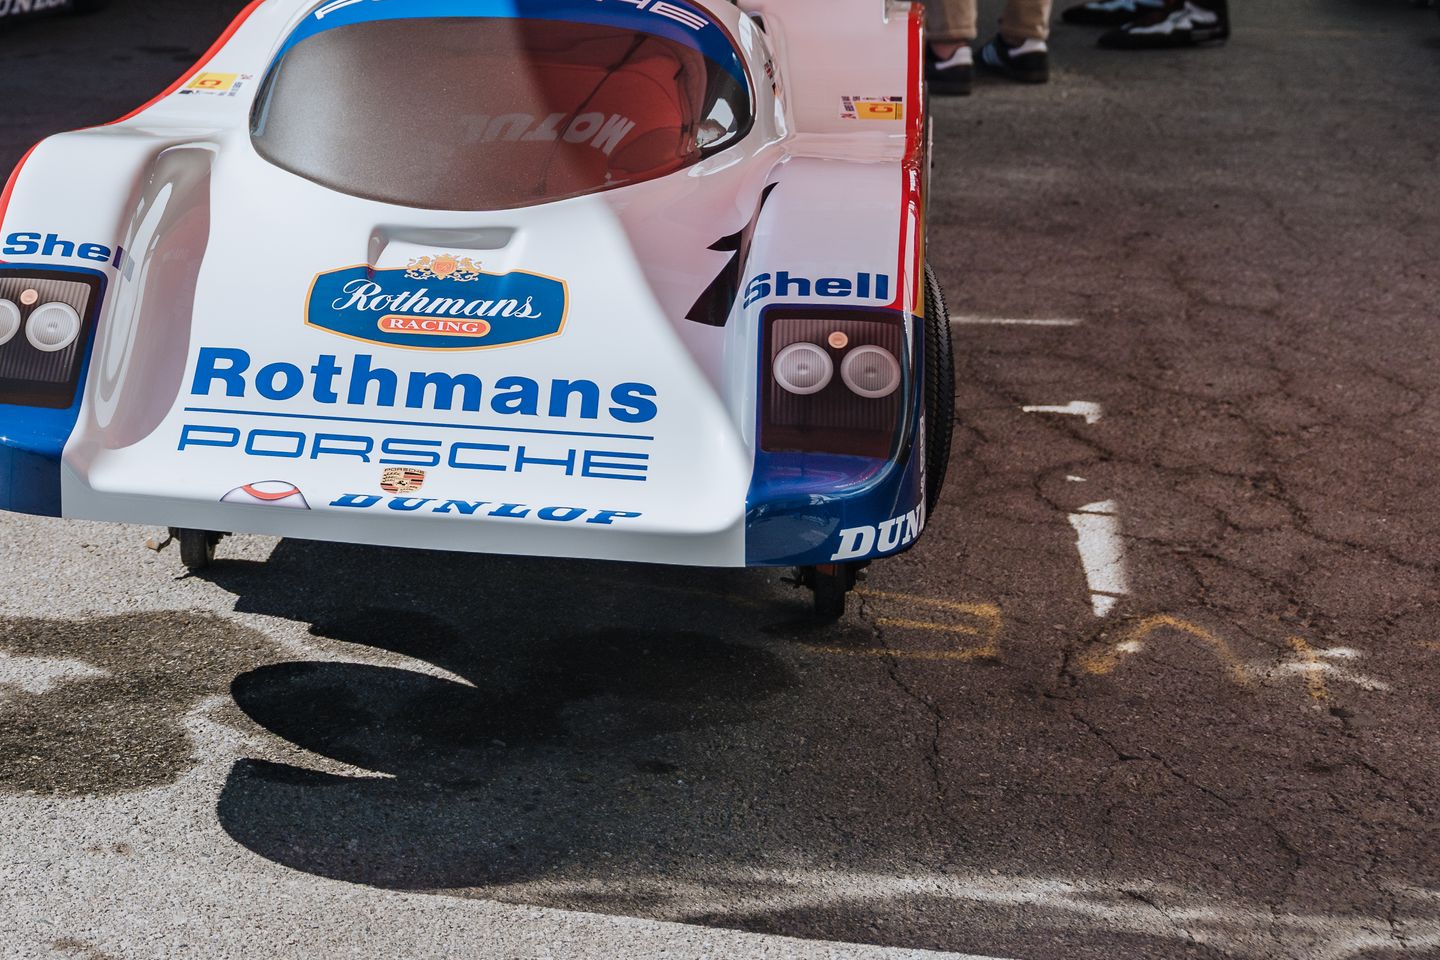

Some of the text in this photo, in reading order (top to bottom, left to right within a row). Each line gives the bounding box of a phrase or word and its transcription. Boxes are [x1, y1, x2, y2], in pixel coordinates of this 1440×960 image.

[332, 279, 542, 319] Rothmans
[743, 271, 889, 310] Shell
[389, 319, 478, 333] RACING
[190, 347, 658, 423] Rothmans
[177, 425, 649, 481] PORSCHE
[328, 493, 643, 525] DUNLOP
